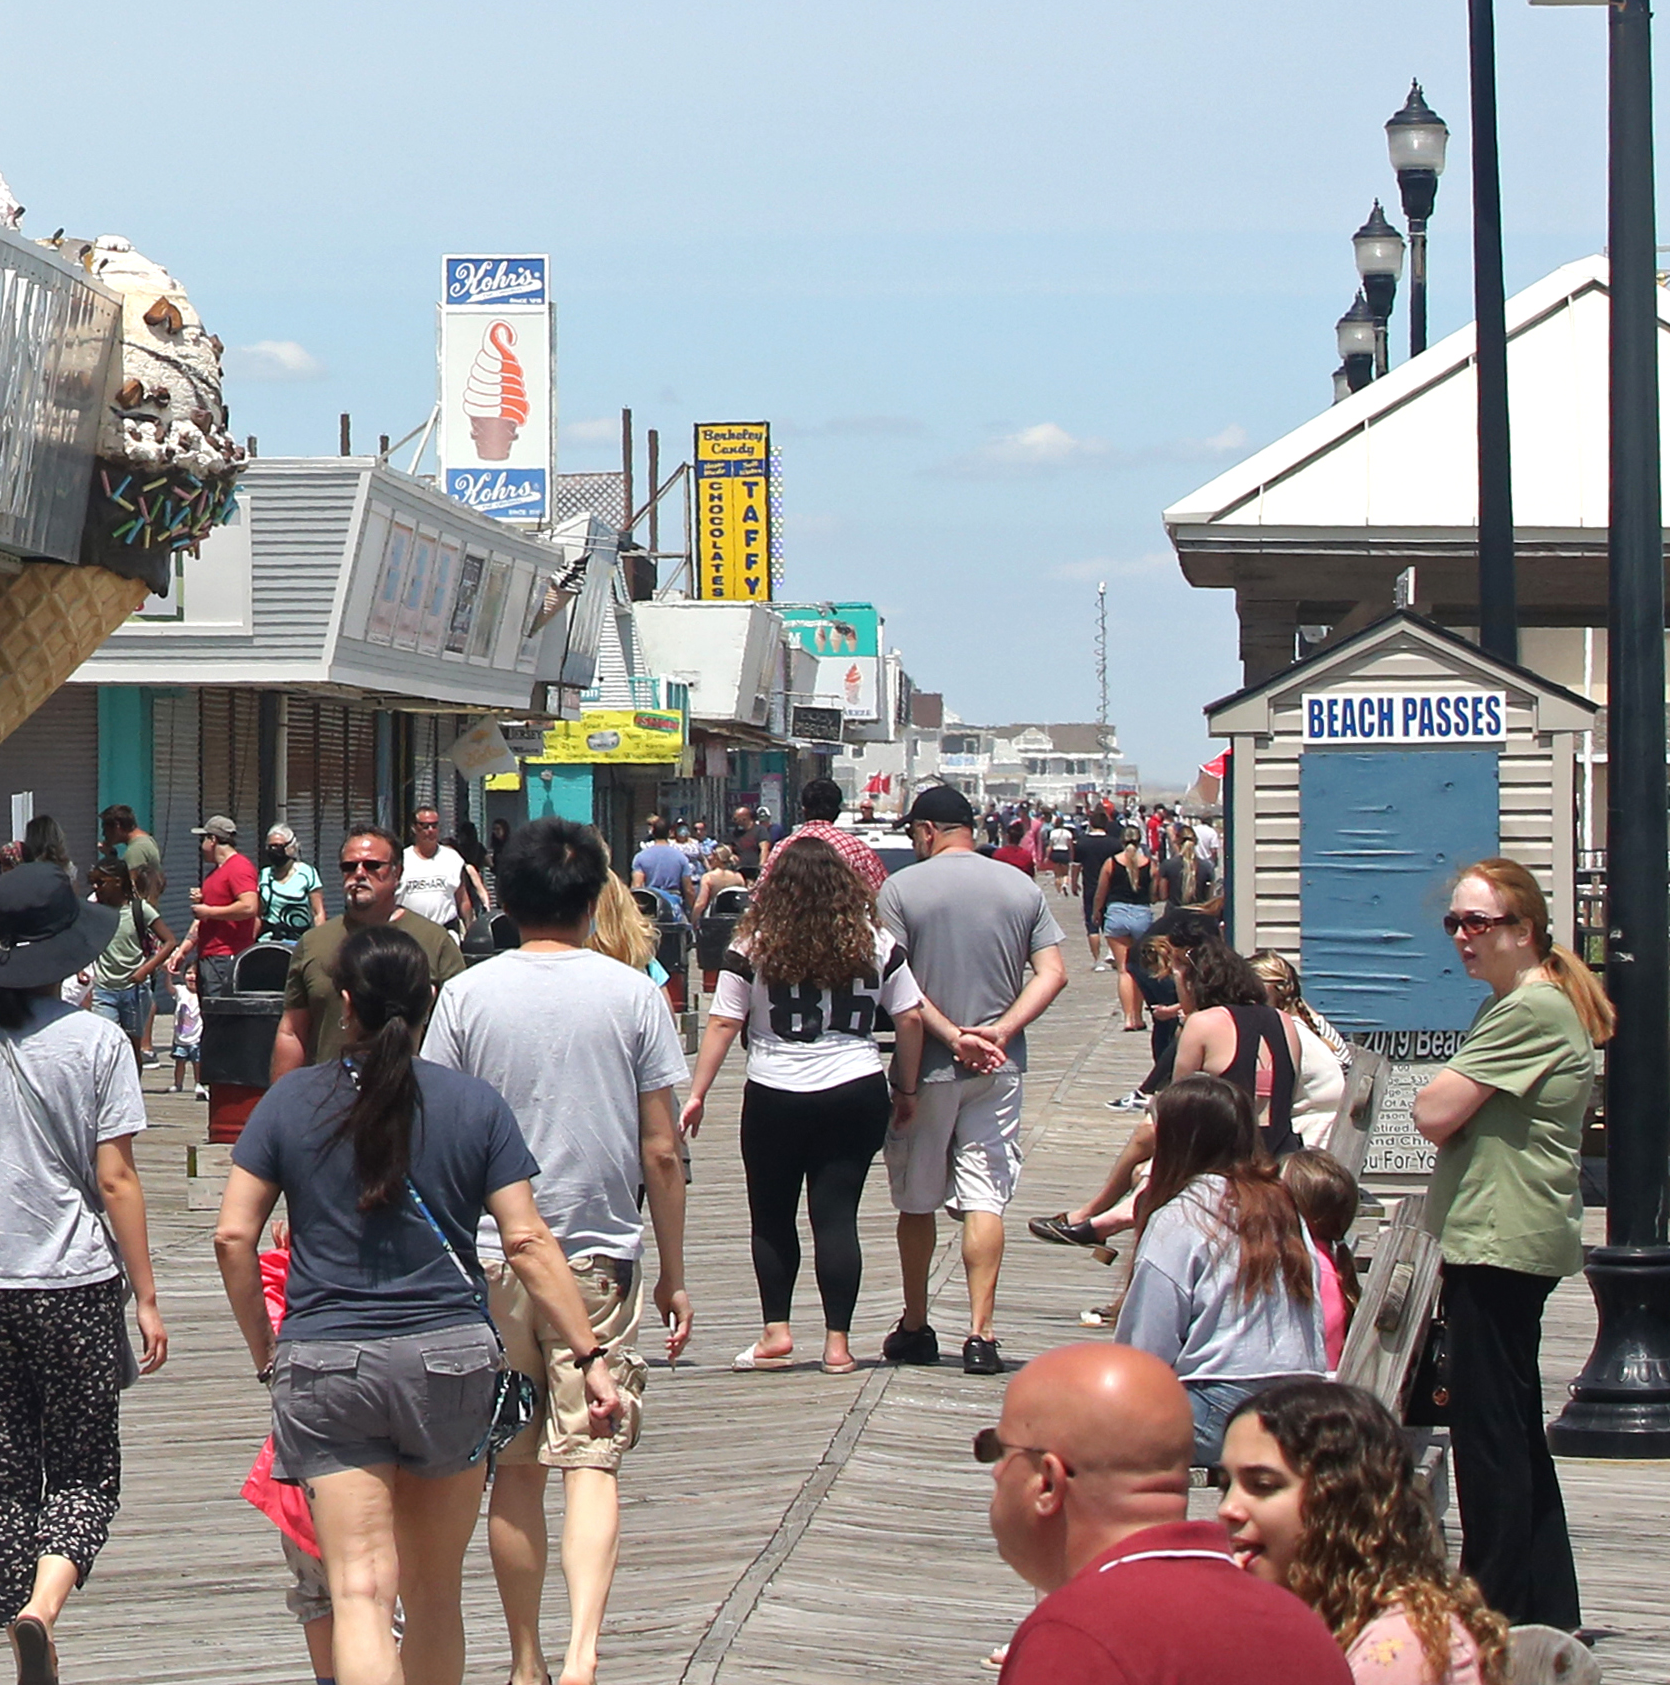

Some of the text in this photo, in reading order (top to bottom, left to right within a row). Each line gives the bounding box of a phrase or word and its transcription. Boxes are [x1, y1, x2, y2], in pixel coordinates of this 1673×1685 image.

[702, 429, 762, 442] Berkeley
[711, 444, 754, 455] Candy
[709, 482, 724, 597] CHOCOLATES
[742, 481, 760, 595] TAFFY
[1308, 696, 1501, 738] BEACH PASSES
[768, 978, 879, 1042] 86
[1384, 1151, 1410, 1169] For
